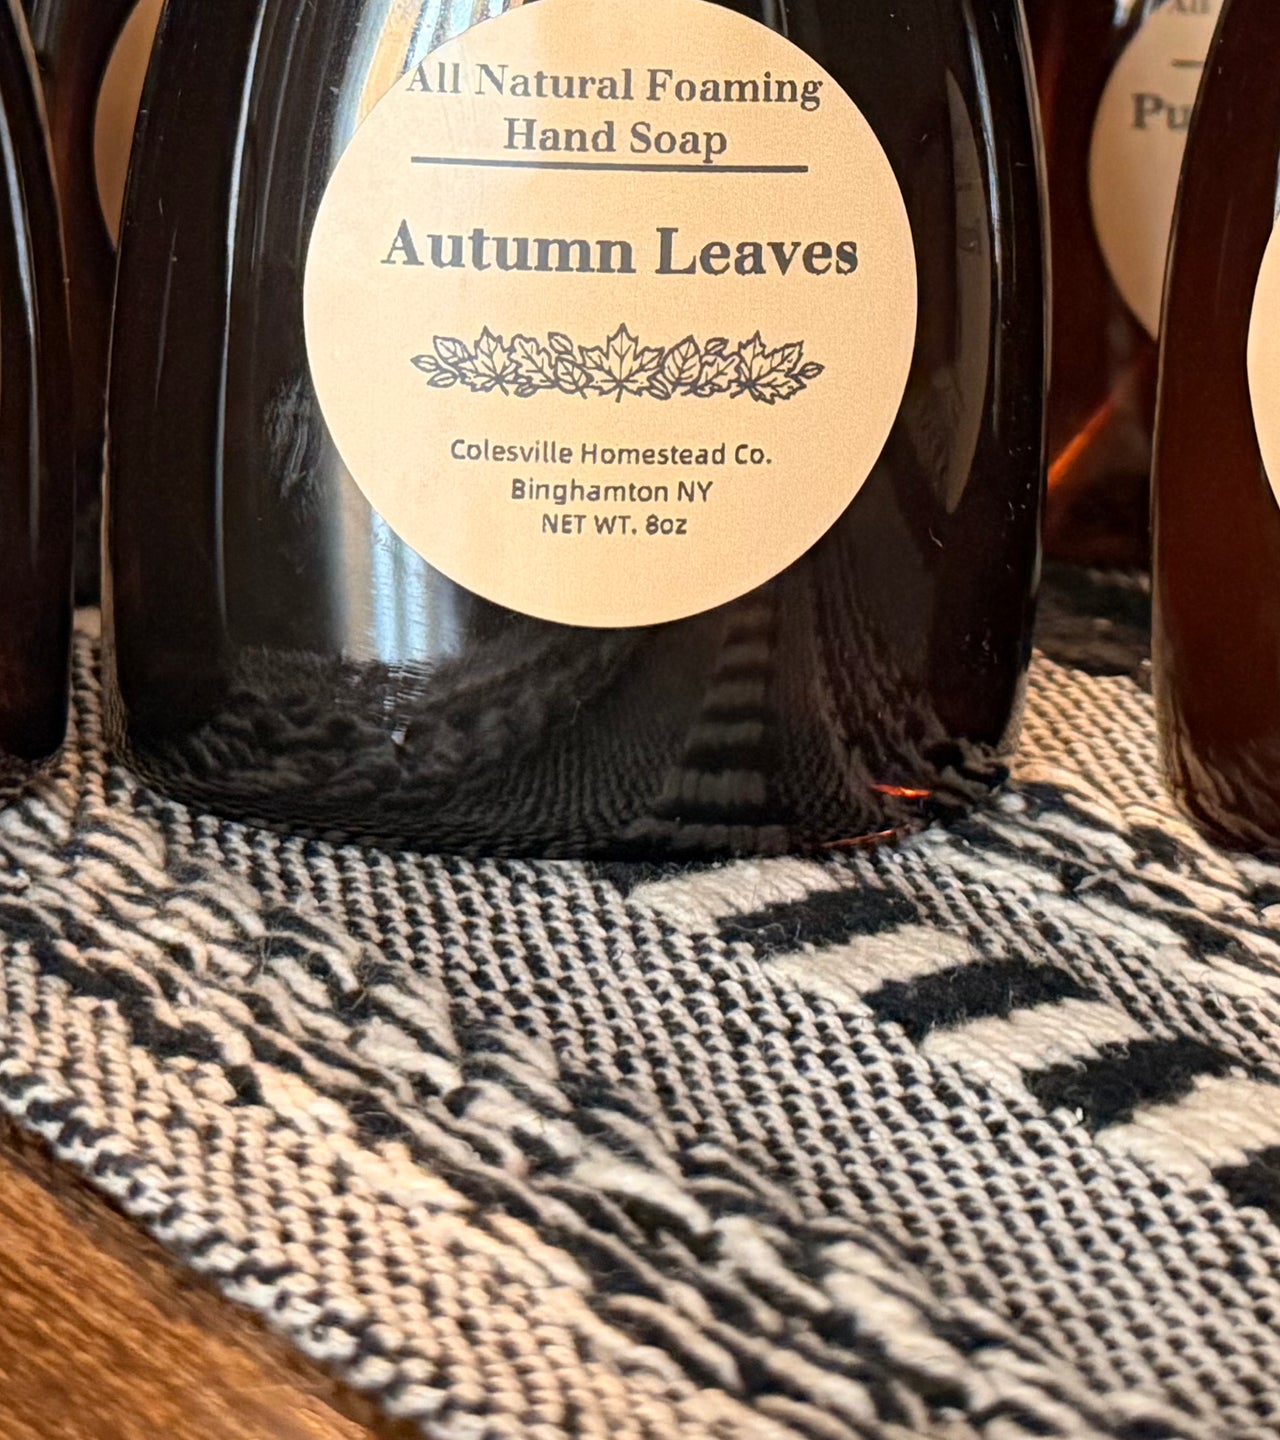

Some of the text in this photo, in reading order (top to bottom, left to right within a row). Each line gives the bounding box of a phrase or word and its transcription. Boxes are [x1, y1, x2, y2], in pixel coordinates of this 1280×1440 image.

[406, 61, 824, 112] All Natural Foaming
[503, 117, 728, 163] Hand Soap
[381, 218, 858, 277] Autumn Leaves
[451, 439, 773, 466] Colesville Homestead Co.
[511, 478, 714, 506] Binghamton NY
[541, 513, 688, 535] NET WT. 8oz
